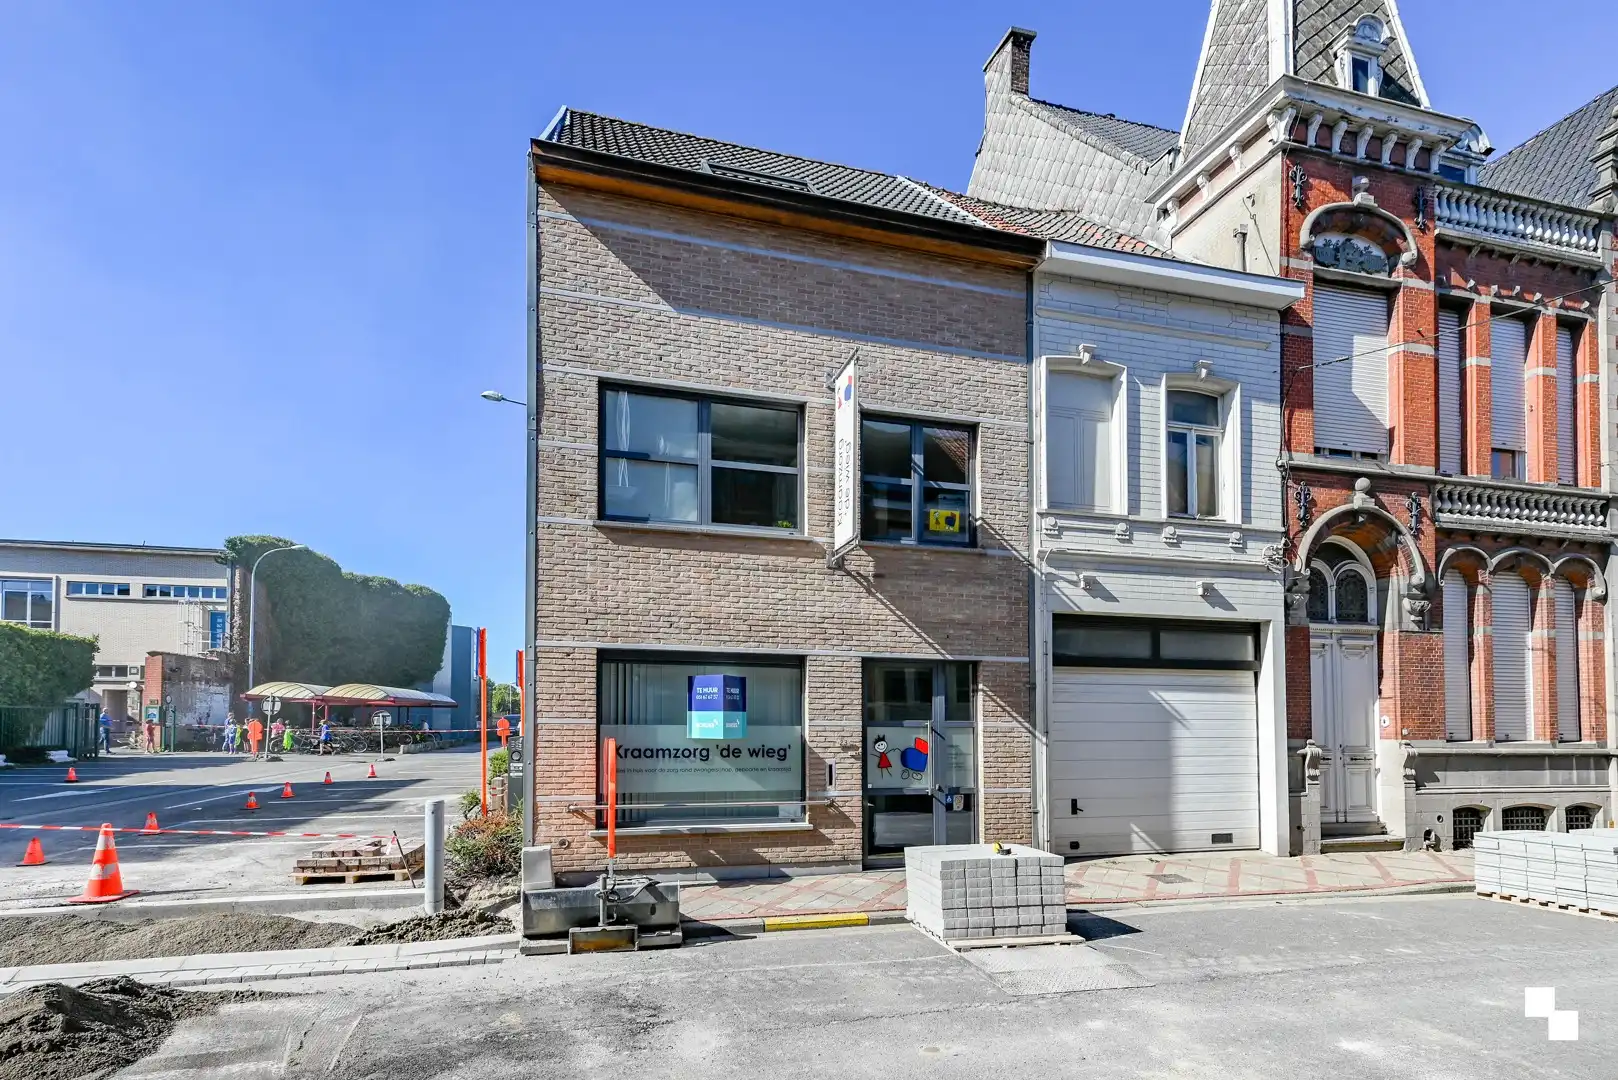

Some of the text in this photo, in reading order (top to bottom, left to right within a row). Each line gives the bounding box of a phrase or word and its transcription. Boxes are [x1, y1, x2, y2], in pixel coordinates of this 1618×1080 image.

[616, 744, 791, 762] Kraamzorg 'de wieg'
